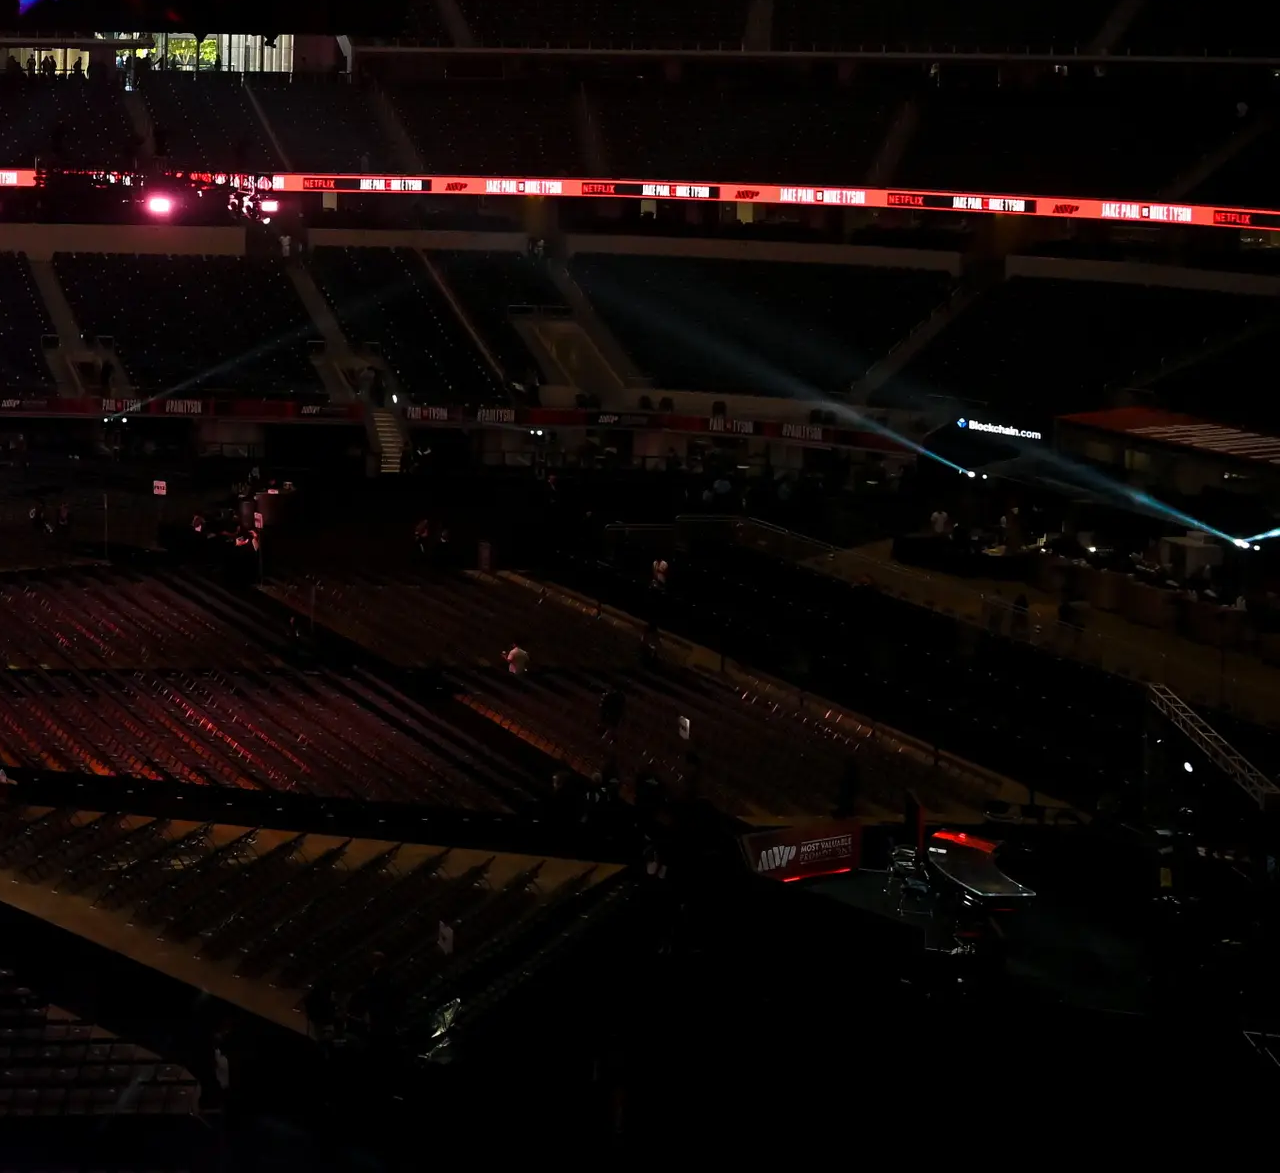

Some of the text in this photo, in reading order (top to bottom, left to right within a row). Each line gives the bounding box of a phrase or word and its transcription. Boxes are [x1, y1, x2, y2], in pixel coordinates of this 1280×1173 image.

[304, 179, 334, 188] NETFLIX
[360, 179, 422, 190] JAKE PAUL TYSON
[486, 180, 562, 194] JAKE PAUL MIKE TYSON
[583, 184, 614, 193] NETFLIX
[643, 185, 709, 197] JAKE PAUL MIKE TYSON
[780, 188, 865, 204] JAKE PAUL MIKE TYSON
[889, 195, 923, 205] NETFLIX
[953, 197, 1025, 212] JAKE PAUL MIKE TYSON
[1102, 203, 1191, 222] JAKE PAUL MIKE TYSON
[1215, 213, 1250, 223] NETFLIX
[103, 399, 141, 412] PAUL TYSON
[166, 400, 202, 413] #PAULTYSON
[407, 407, 448, 420] PAUL TYSON
[477, 408, 515, 422] #PAULTYSON
[710, 418, 754, 433] PAUL TYSON
[782, 423, 823, 440] #PAULTYSON
[969, 420, 1041, 440] Blockchain.com
[801, 837, 851, 853] MOST VALUABLE
